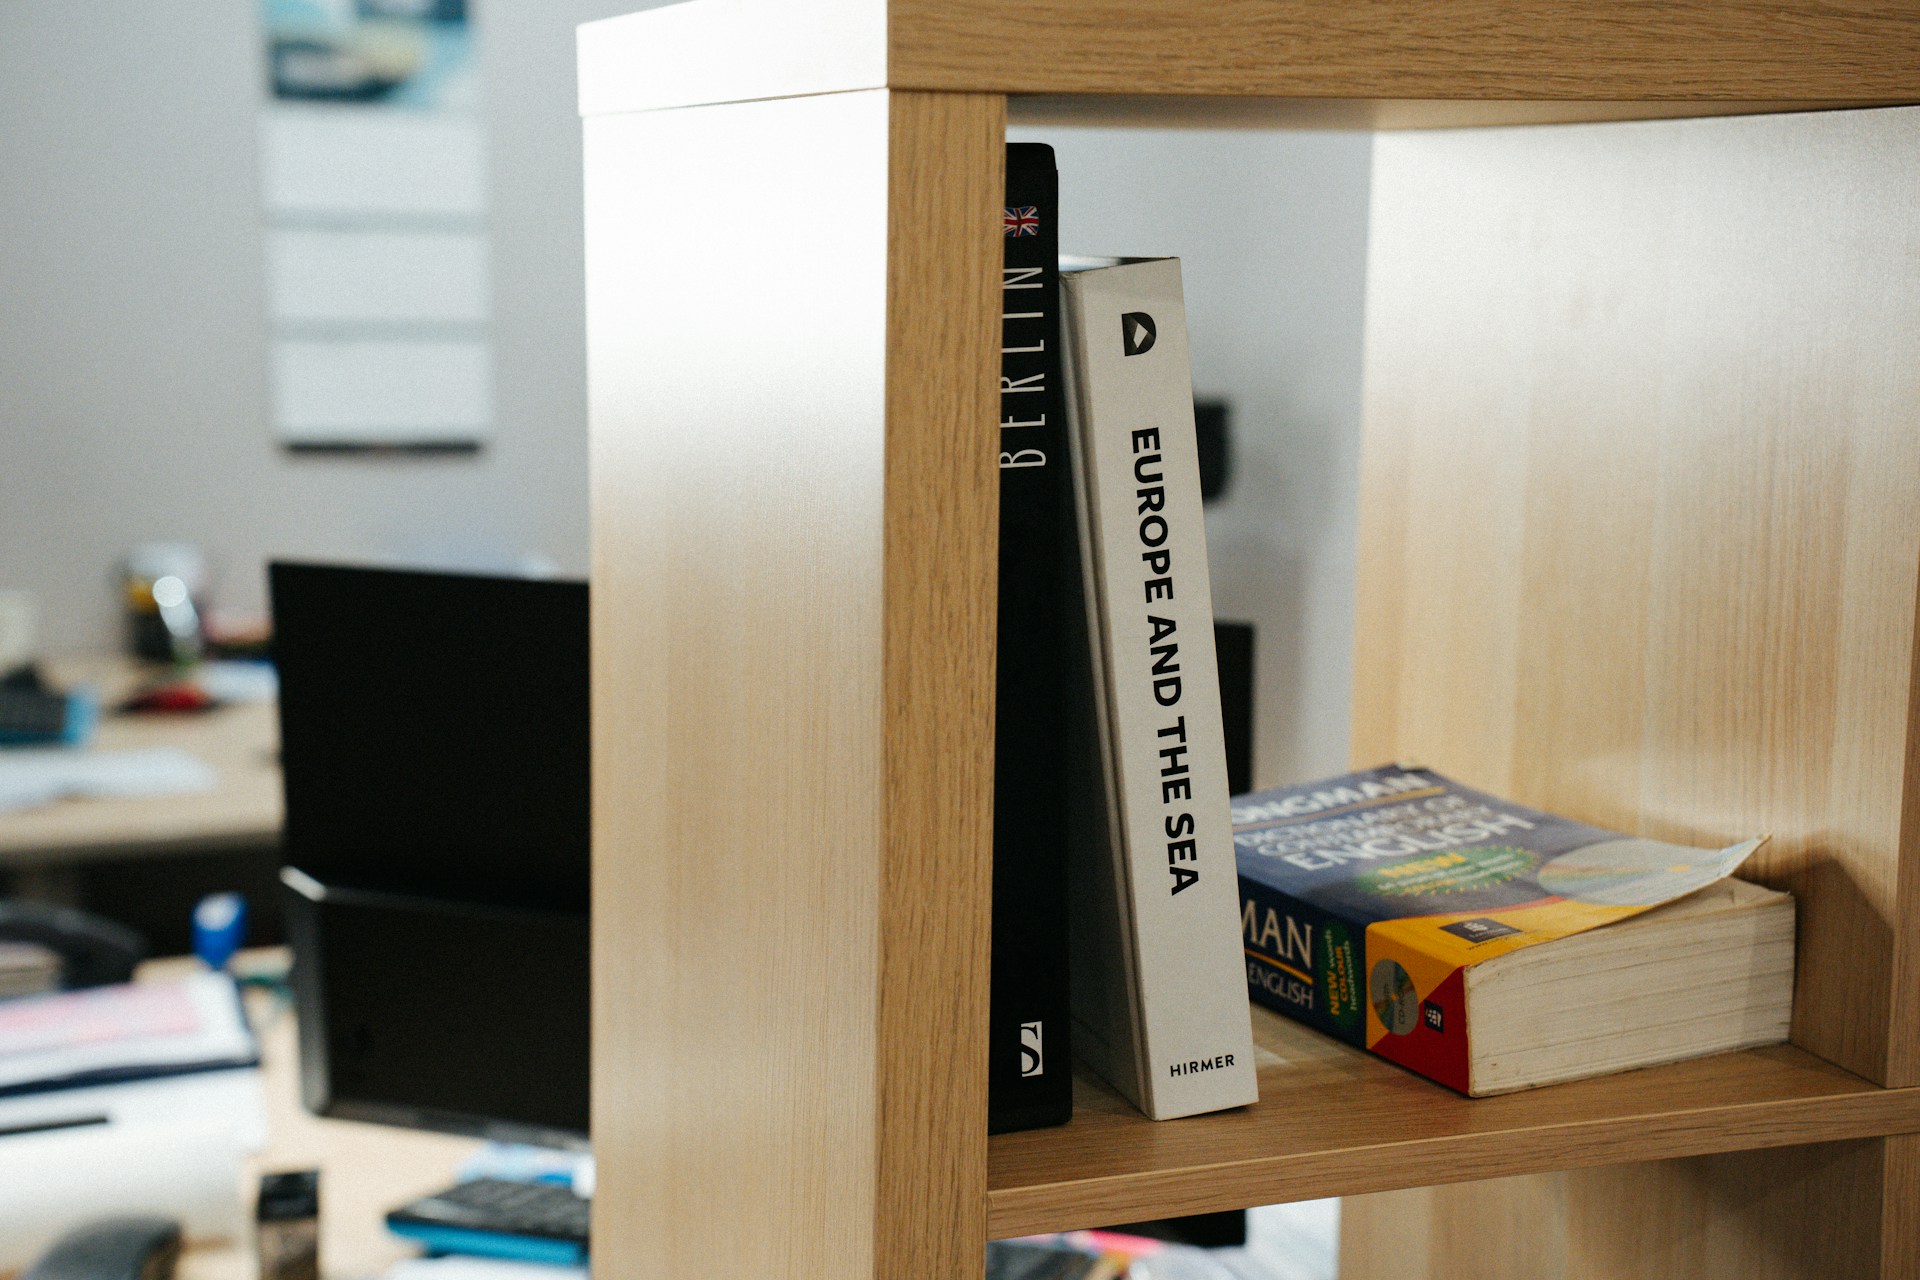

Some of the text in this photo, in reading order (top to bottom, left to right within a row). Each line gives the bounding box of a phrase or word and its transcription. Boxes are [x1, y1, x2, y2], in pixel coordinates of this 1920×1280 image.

[999, 267, 1047, 469] BERLIN
[1131, 426, 1199, 897] EUROPE AND THE SEA
[1283, 813, 1536, 872] ENGLISH
[1247, 961, 1315, 1010] ENGLISH
[1327, 970, 1340, 1016] NEW
[1335, 946, 1349, 1002] COLOUR
[1169, 1054, 1235, 1077] HIRMER
